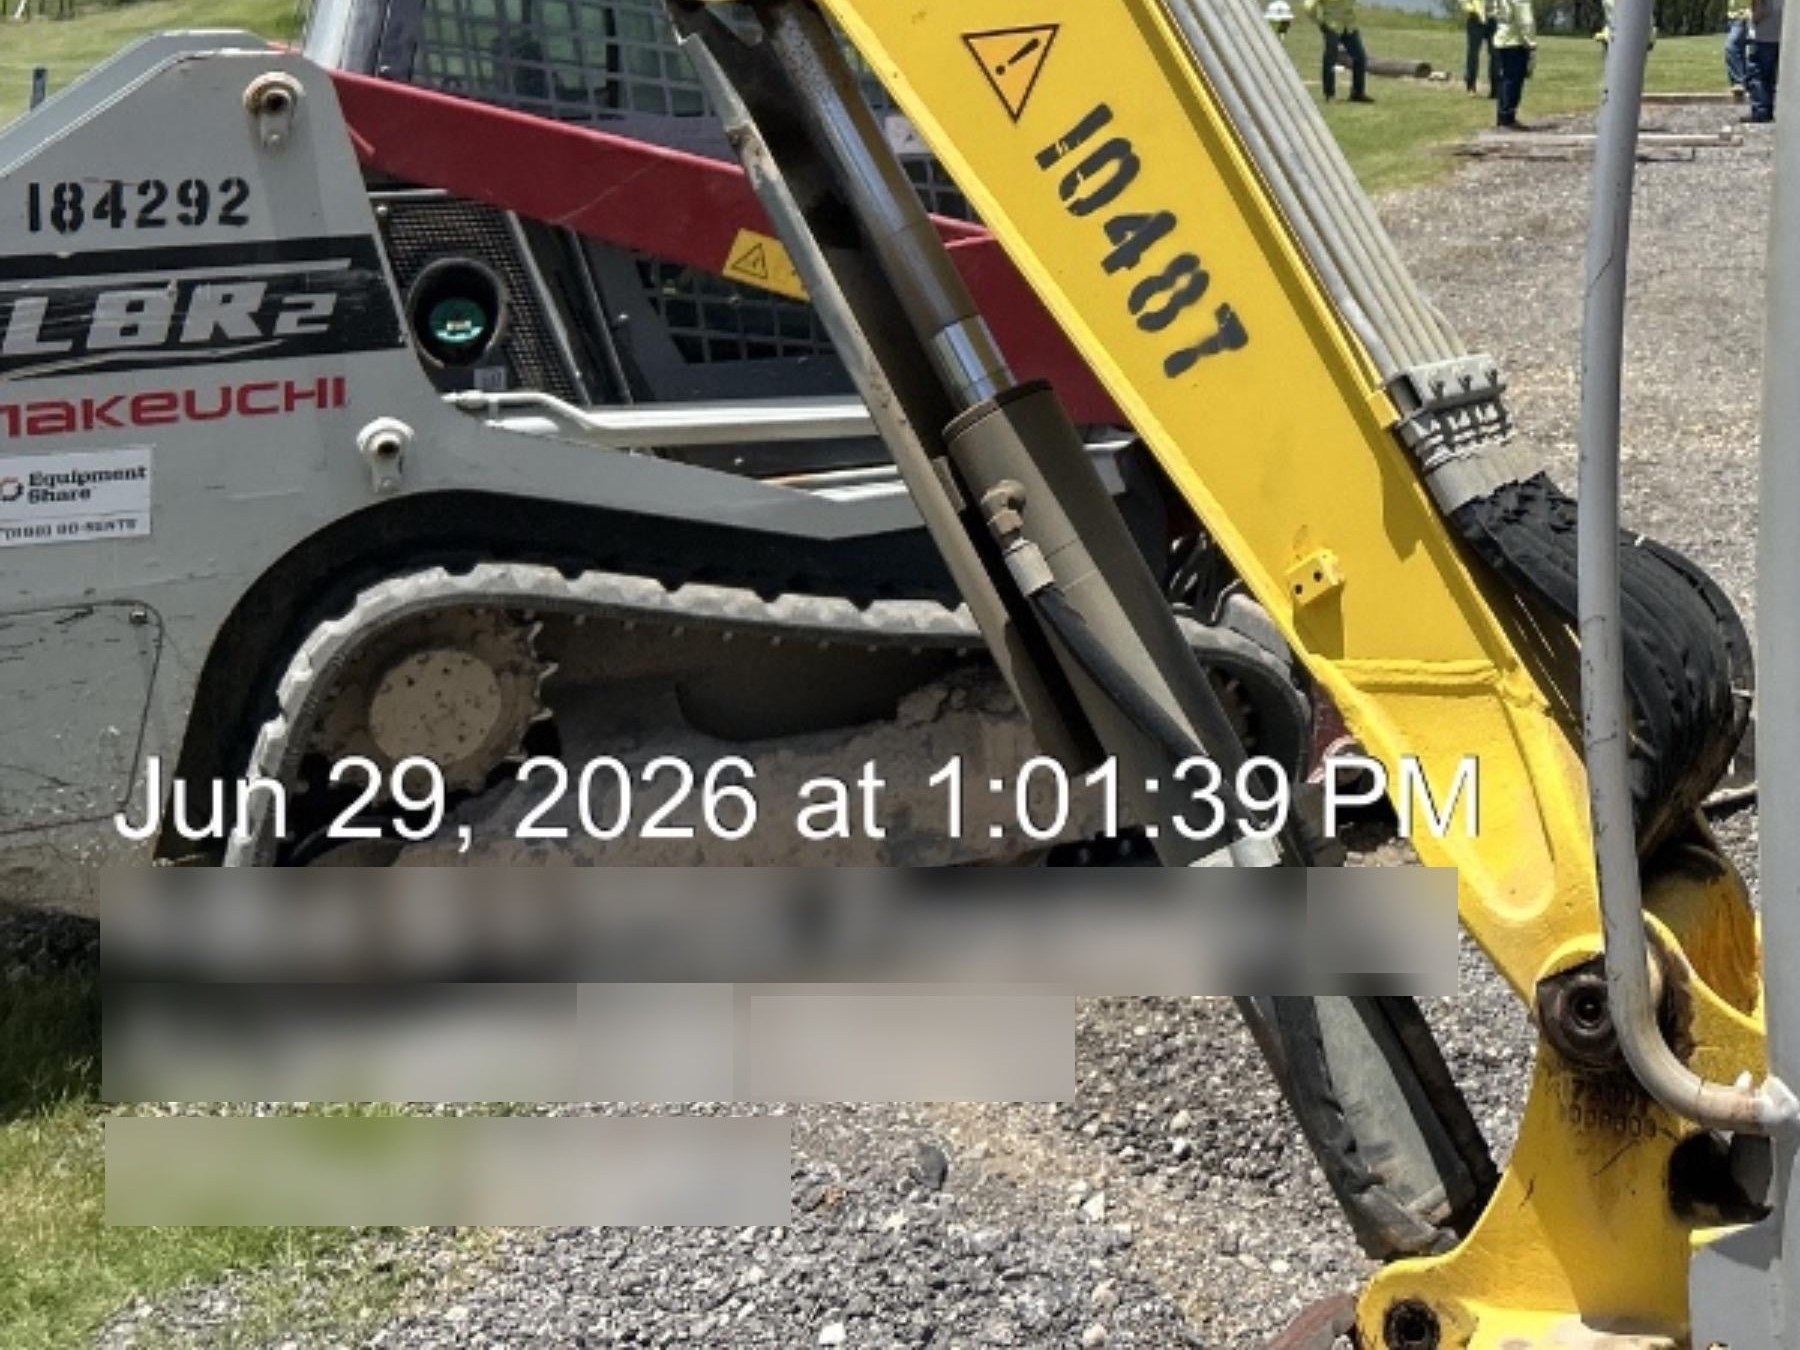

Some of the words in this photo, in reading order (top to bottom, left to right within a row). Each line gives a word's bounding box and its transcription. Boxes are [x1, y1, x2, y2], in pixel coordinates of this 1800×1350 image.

[27, 177, 251, 234] 184292
[1034, 103, 1250, 379] 10487
[28, 465, 148, 489] Equipment
[28, 488, 92, 505] Share
